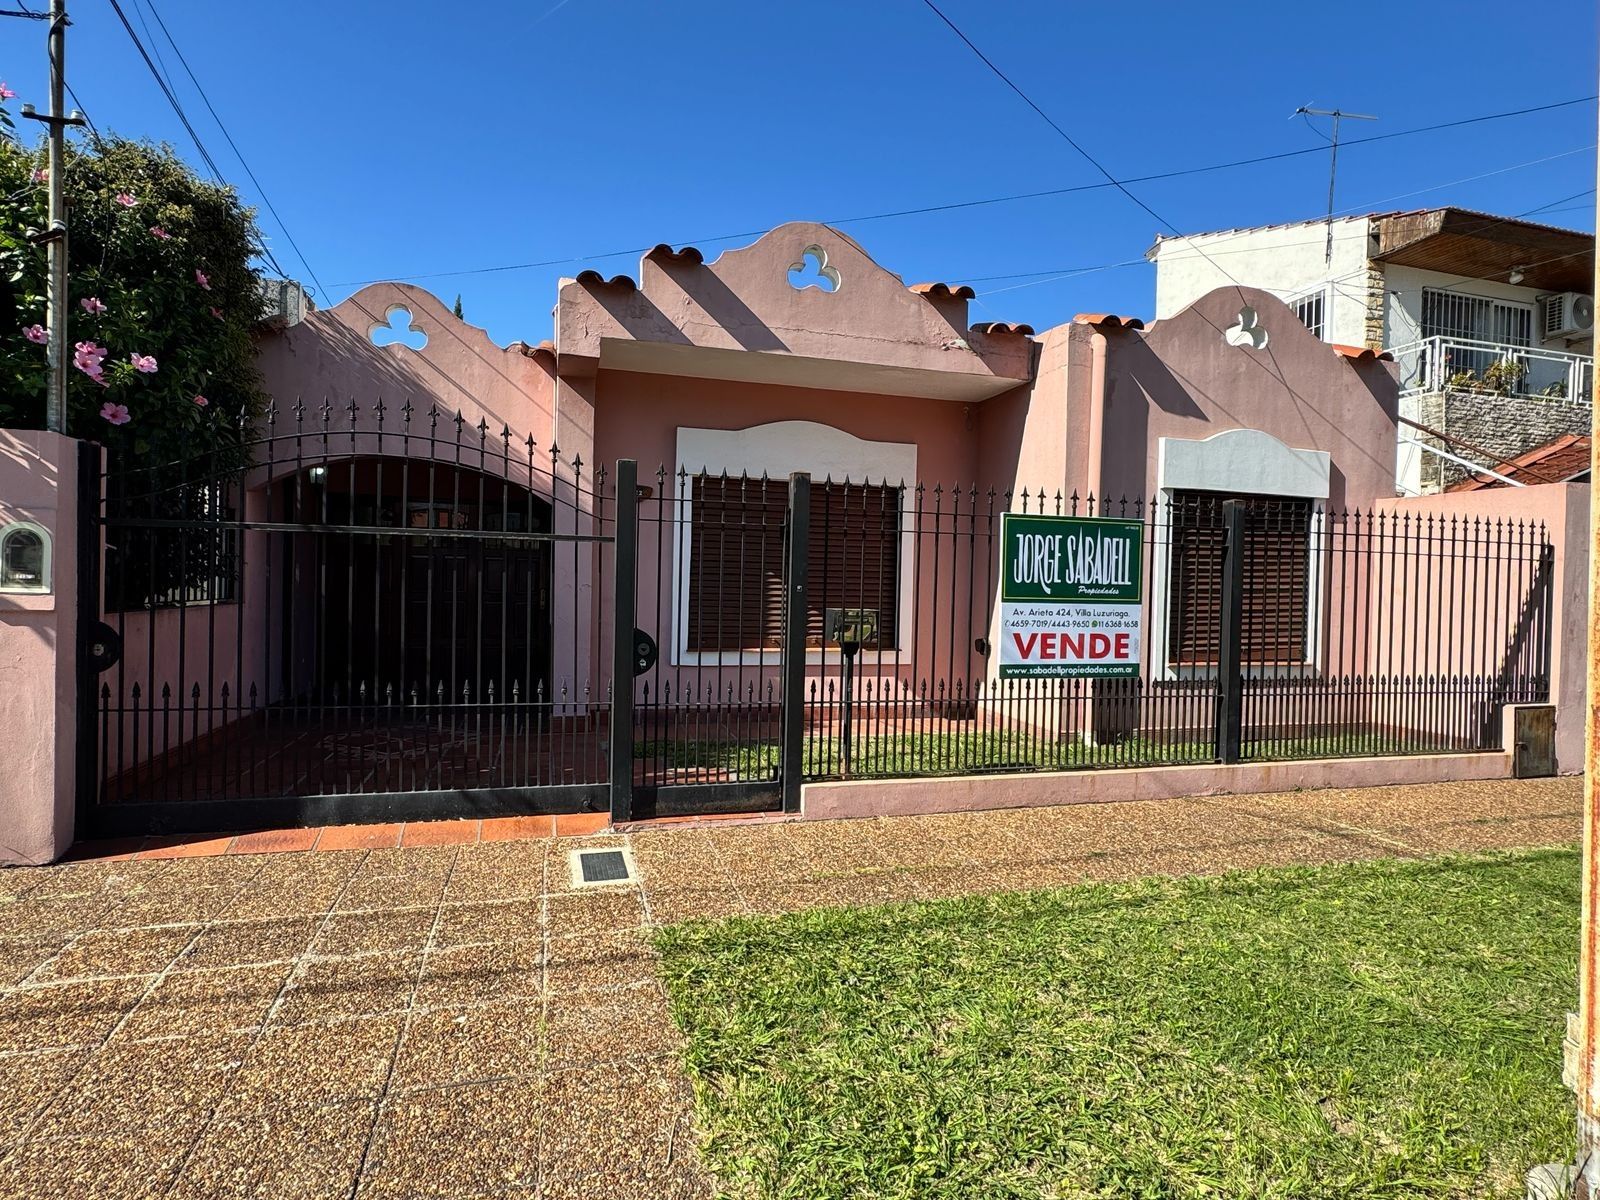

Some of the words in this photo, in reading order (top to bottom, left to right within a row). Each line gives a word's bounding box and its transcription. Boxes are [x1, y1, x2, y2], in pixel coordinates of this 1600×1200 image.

[1013, 533, 1063, 594] JORGE
[1065, 525, 1132, 585] SABADELL
[1078, 585, 1120, 596] Propiedades
[1012, 608, 1027, 616] Av.
[1055, 608, 1073, 618] 424,
[1075, 609, 1092, 617] Villa
[1012, 632, 1130, 660] VENDE
[1006, 666, 1133, 676] www.sabadellpropiedades.com.ar
